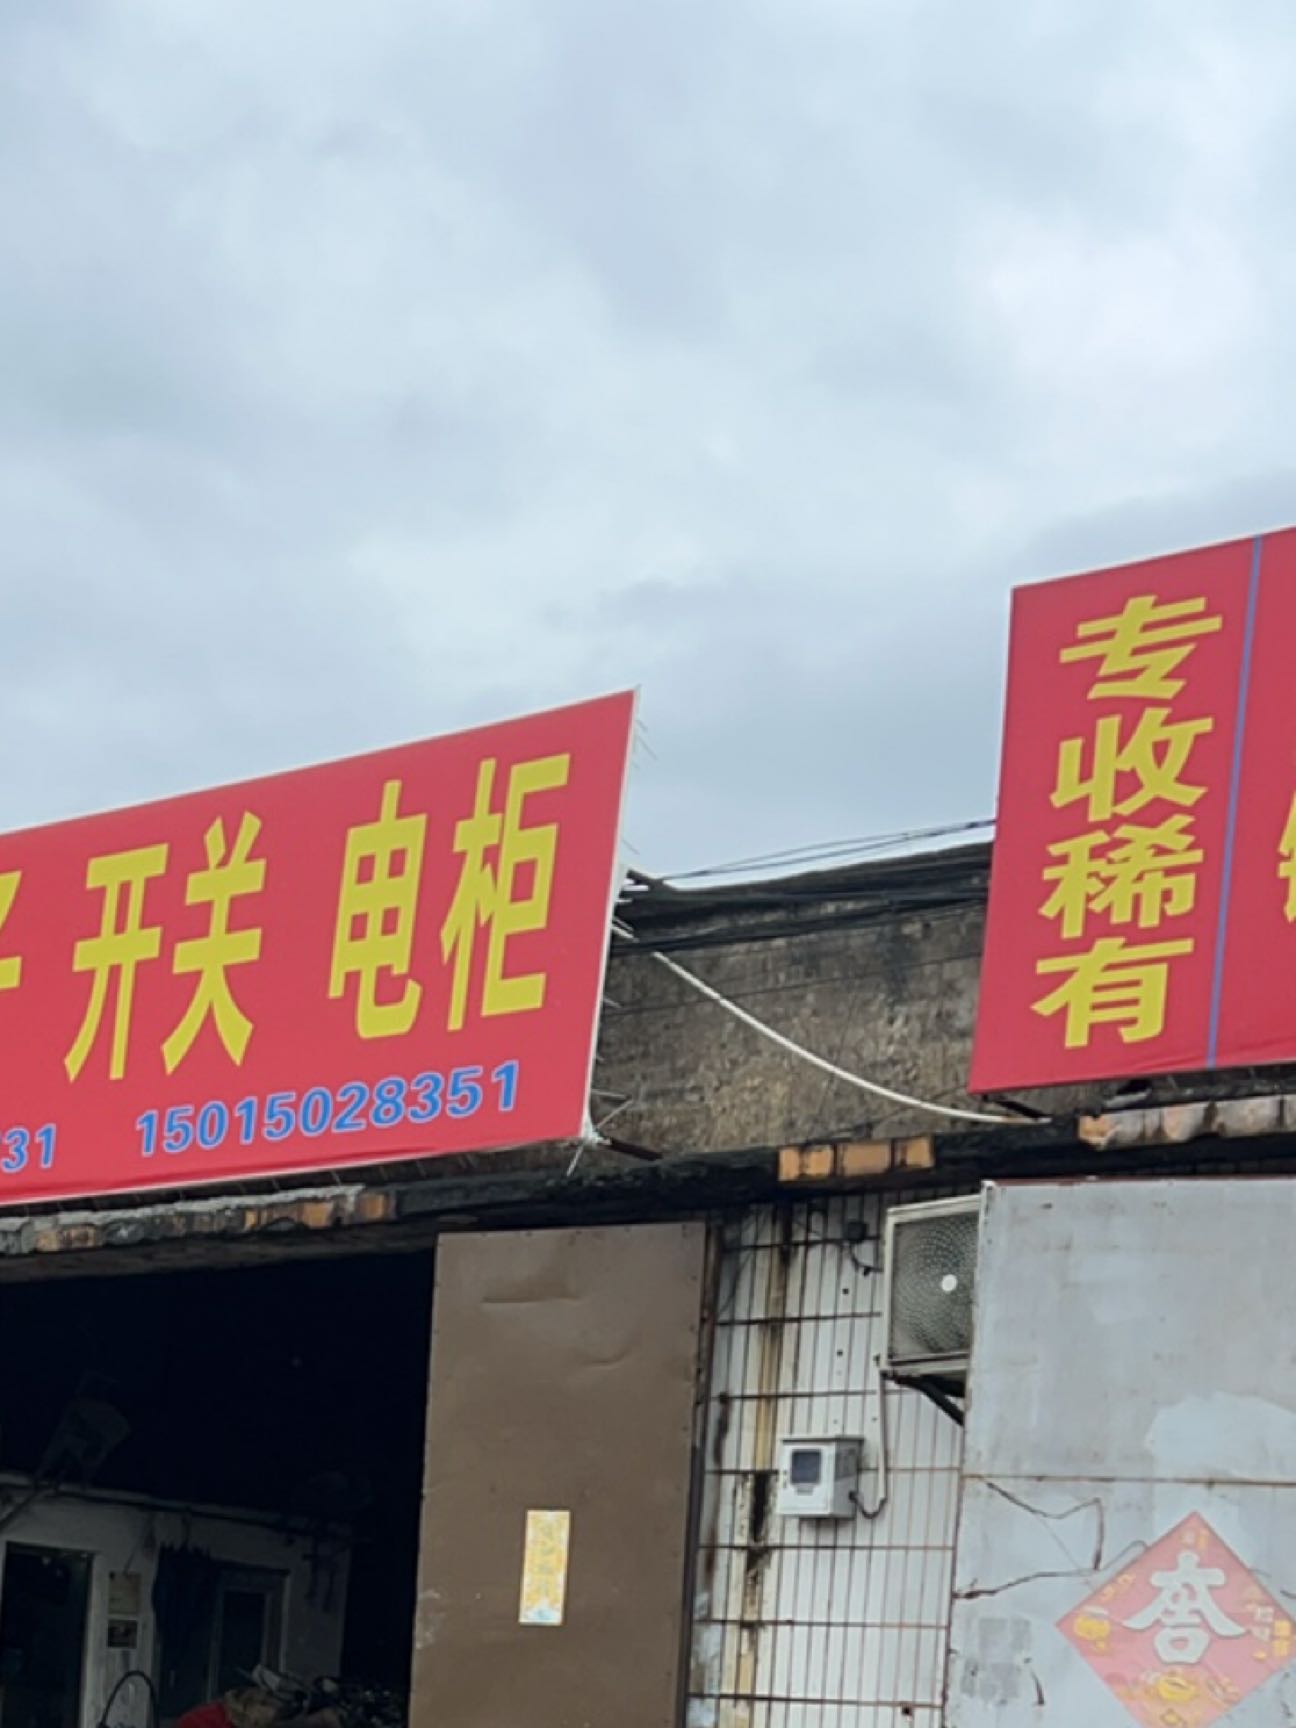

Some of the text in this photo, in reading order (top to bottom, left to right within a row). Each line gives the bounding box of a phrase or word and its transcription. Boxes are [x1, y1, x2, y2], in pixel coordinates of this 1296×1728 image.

[65, 811, 267, 1082] 开关
[328, 753, 571, 1040] 电柜
[1031, 595, 1223, 1049] 专收稀有
[135, 1058, 520, 1158] 15015028351
